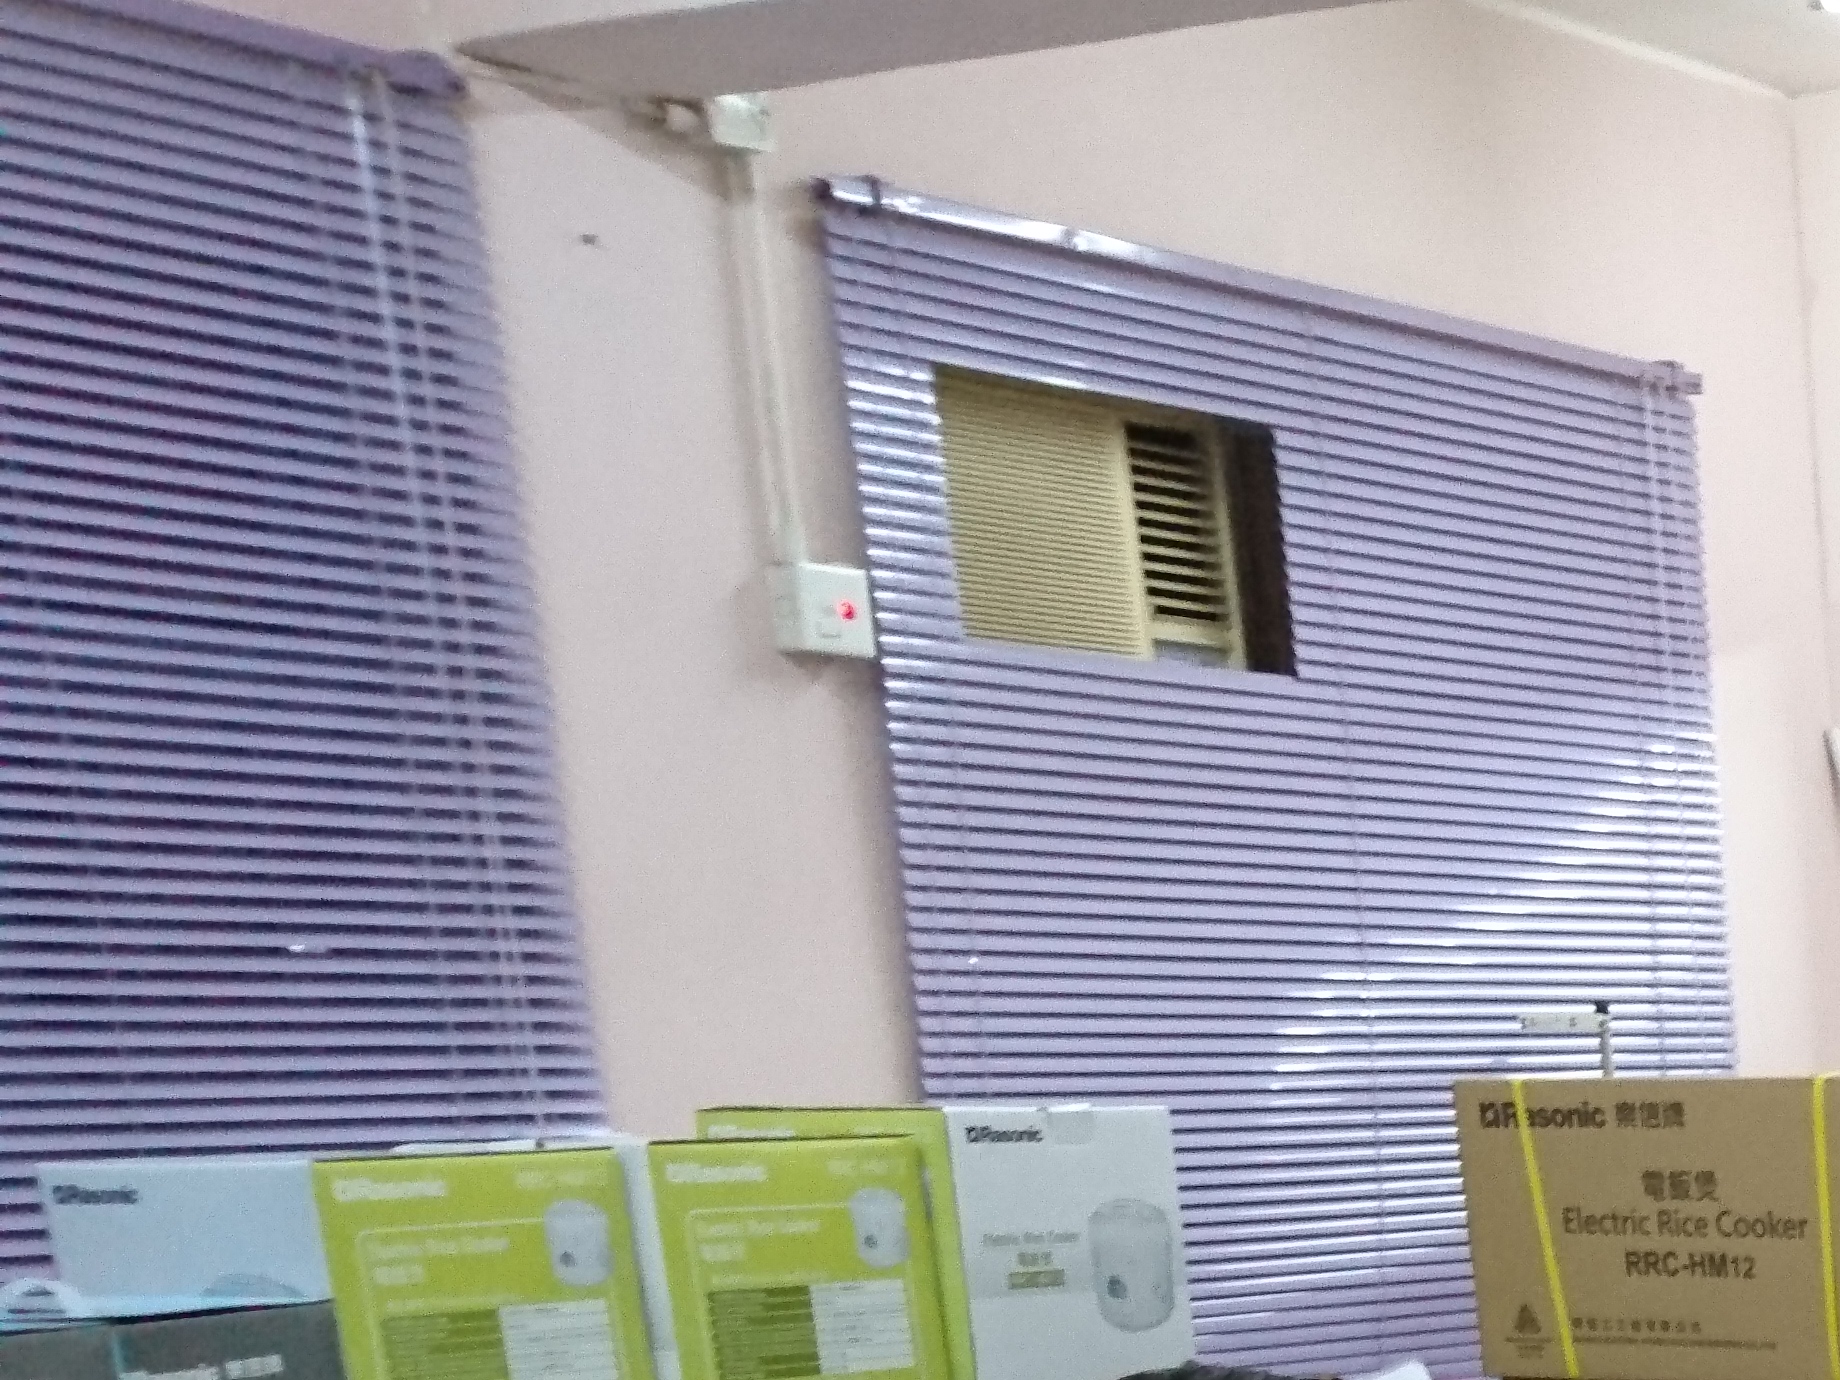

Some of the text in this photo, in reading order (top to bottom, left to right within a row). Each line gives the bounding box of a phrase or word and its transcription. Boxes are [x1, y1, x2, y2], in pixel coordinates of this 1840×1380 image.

[1562, 1206, 1807, 1239] Electric Rice Cooker
[1625, 1250, 1756, 1280] RRC-HM12
